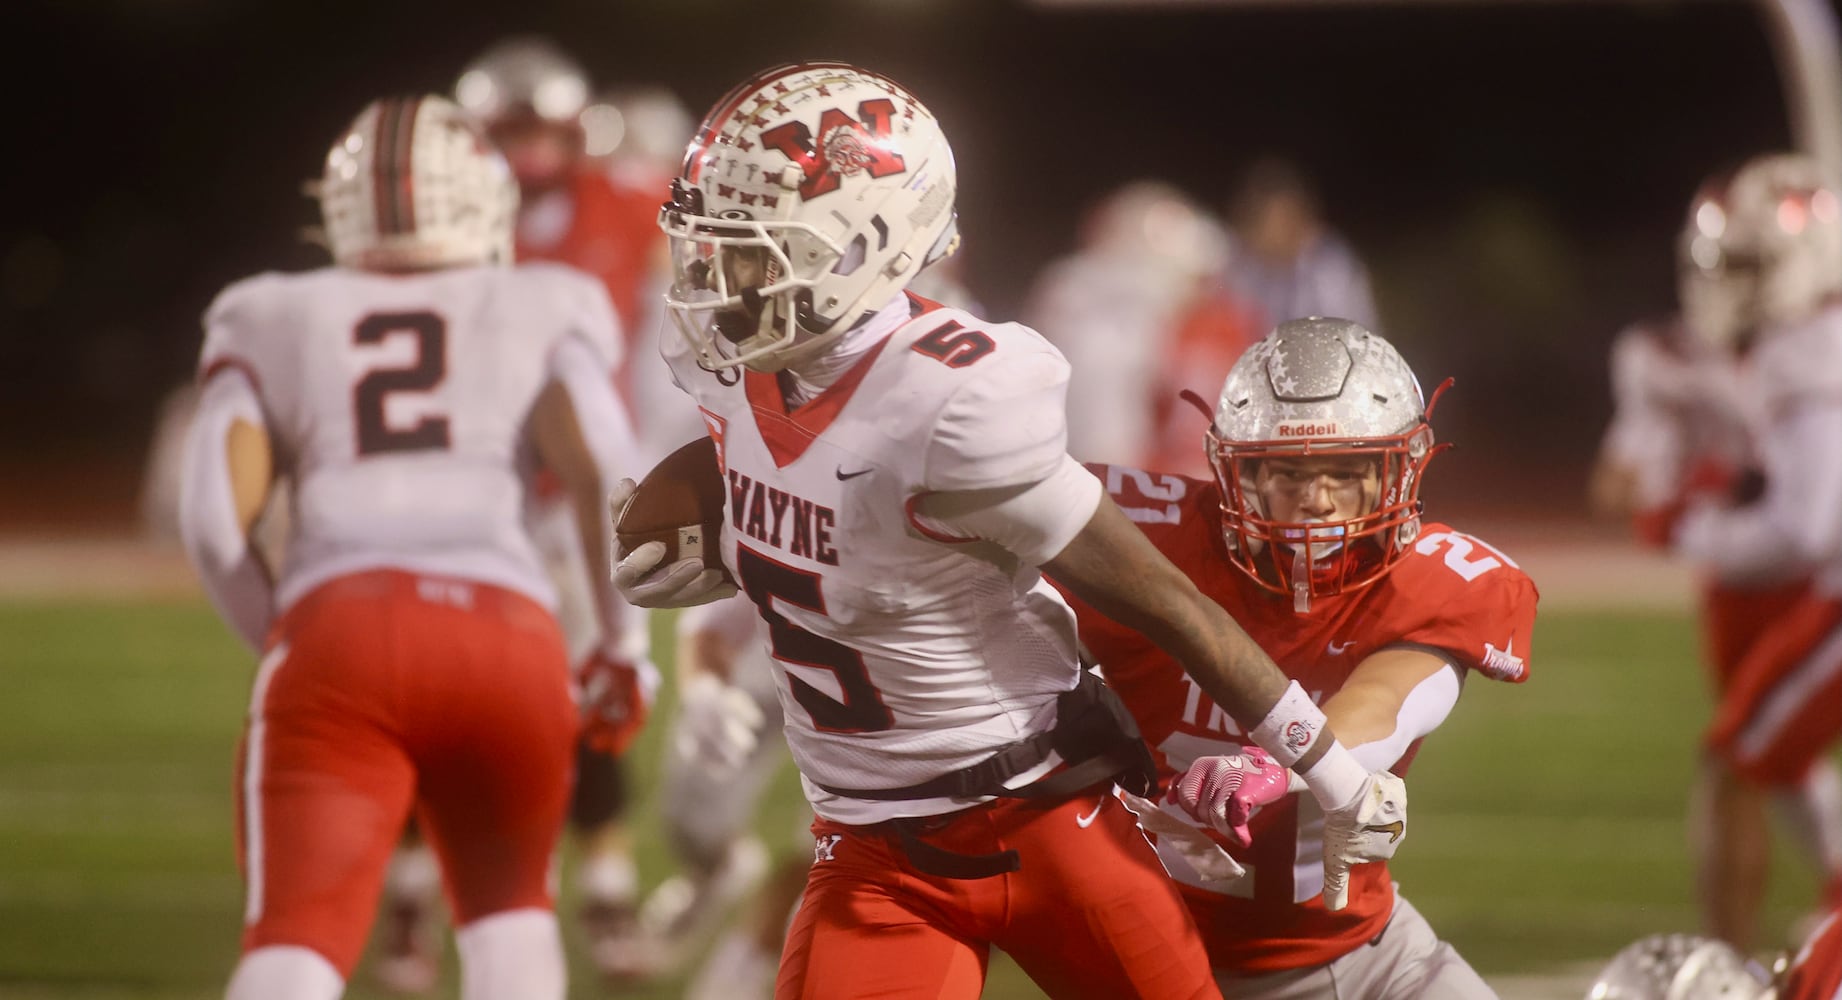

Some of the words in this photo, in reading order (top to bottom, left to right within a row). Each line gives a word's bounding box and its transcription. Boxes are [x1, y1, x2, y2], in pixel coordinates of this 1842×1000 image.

[759, 98, 906, 202] W
[351, 309, 452, 457] 2
[910, 319, 996, 369] 5
[1279, 423, 1337, 436] Riddell
[728, 468, 840, 567] WAYNE
[1106, 464, 1187, 526] 21
[736, 539, 896, 734] 5
